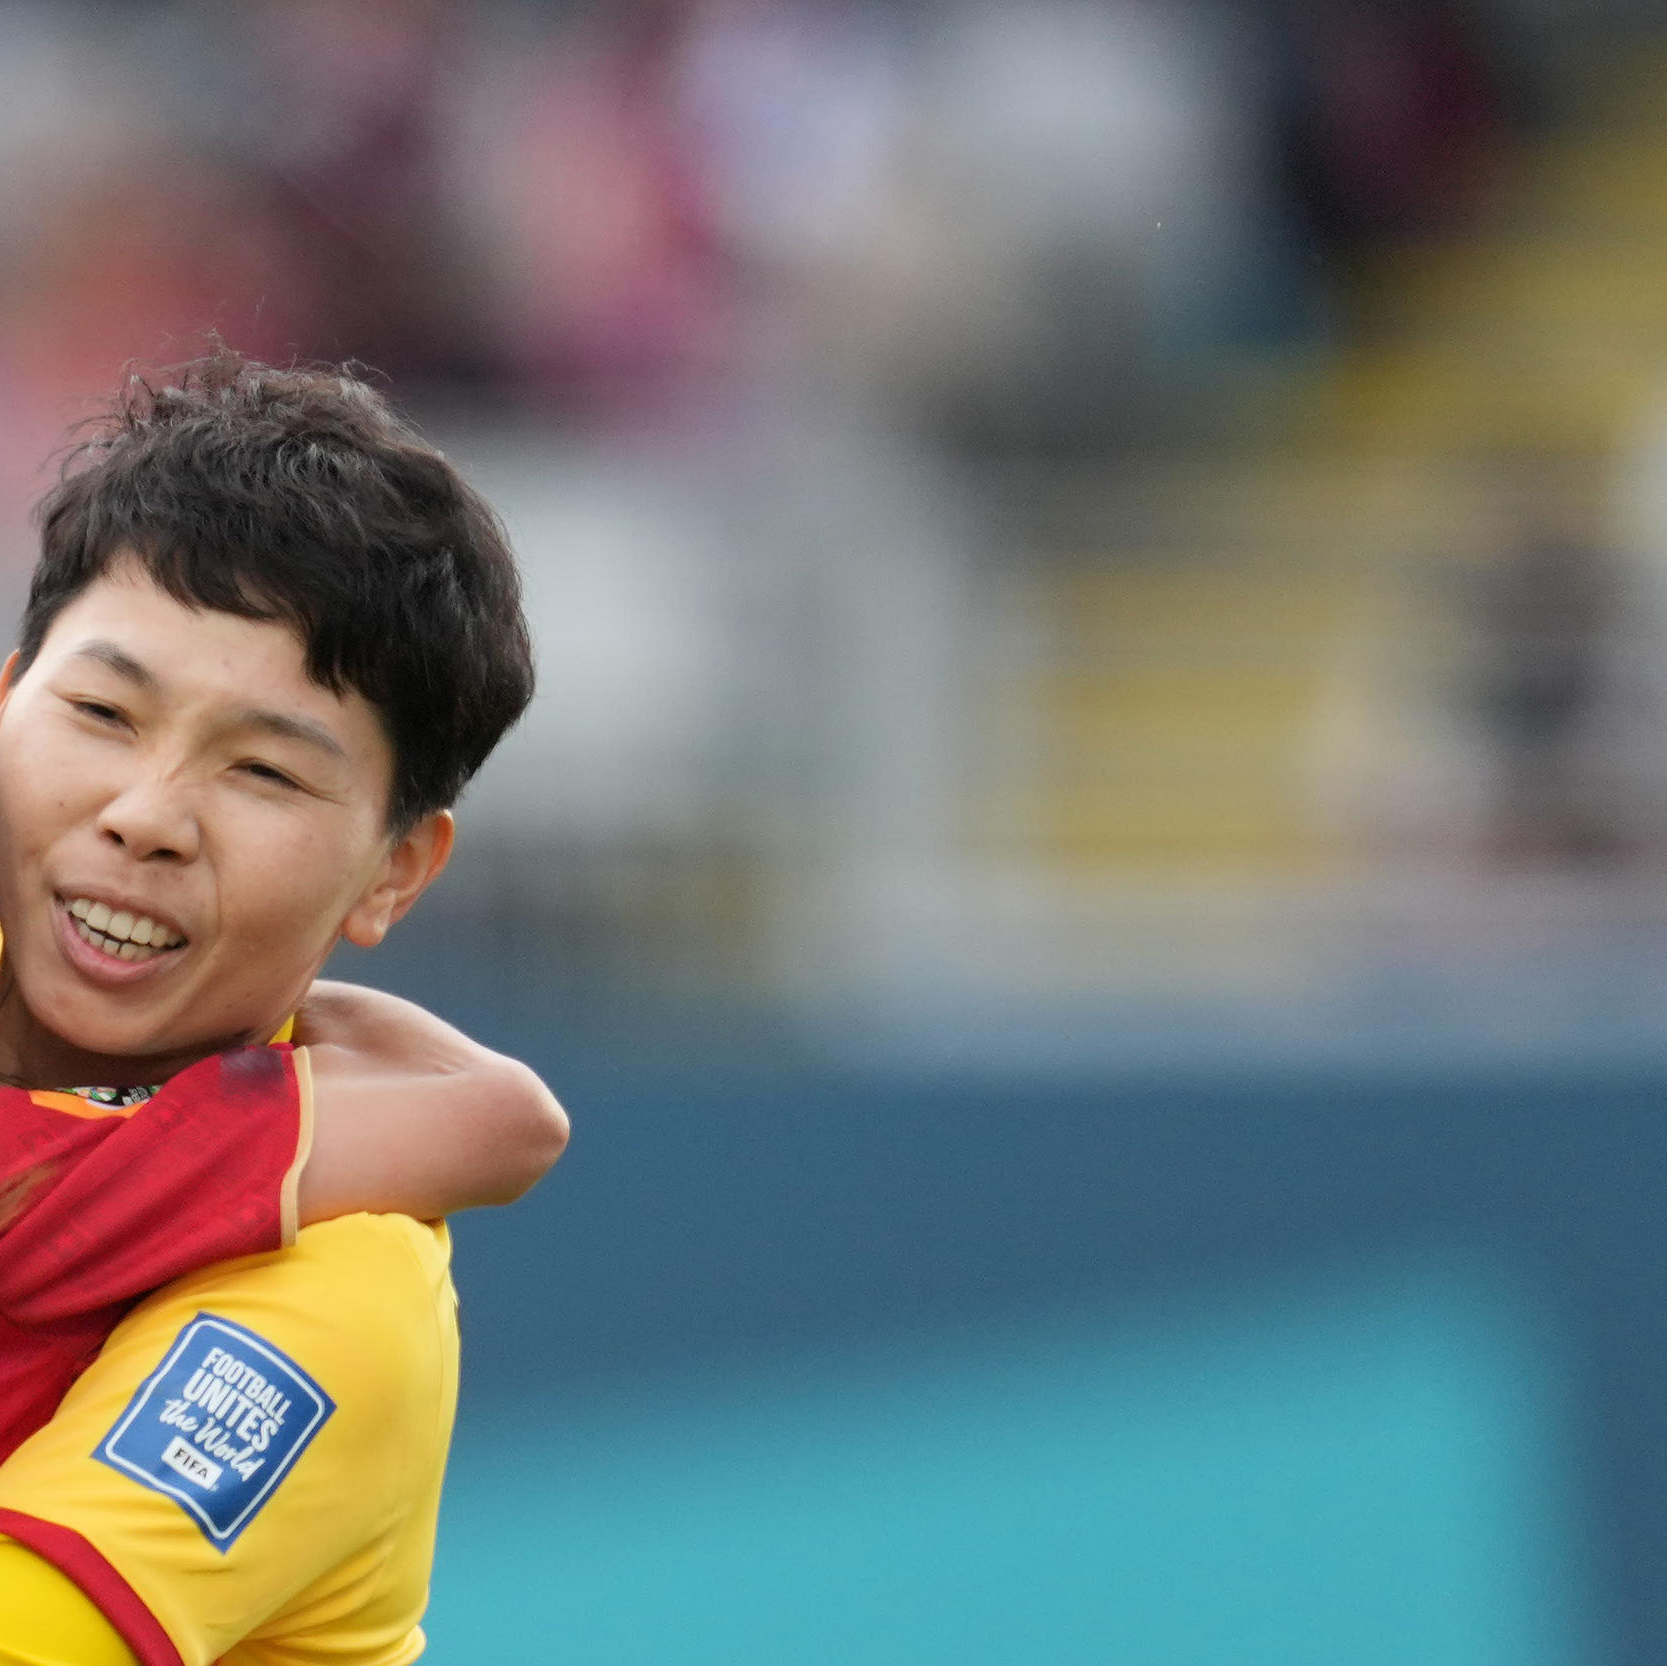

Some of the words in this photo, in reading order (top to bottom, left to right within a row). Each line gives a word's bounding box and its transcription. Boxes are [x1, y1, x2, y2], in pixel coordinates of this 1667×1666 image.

[183, 1368, 279, 1451] UNITES
[202, 1347, 292, 1426] FOOTBALL
[159, 1399, 199, 1432] the
[194, 1417, 266, 1482] World
[173, 1447, 209, 1479] FIFA
